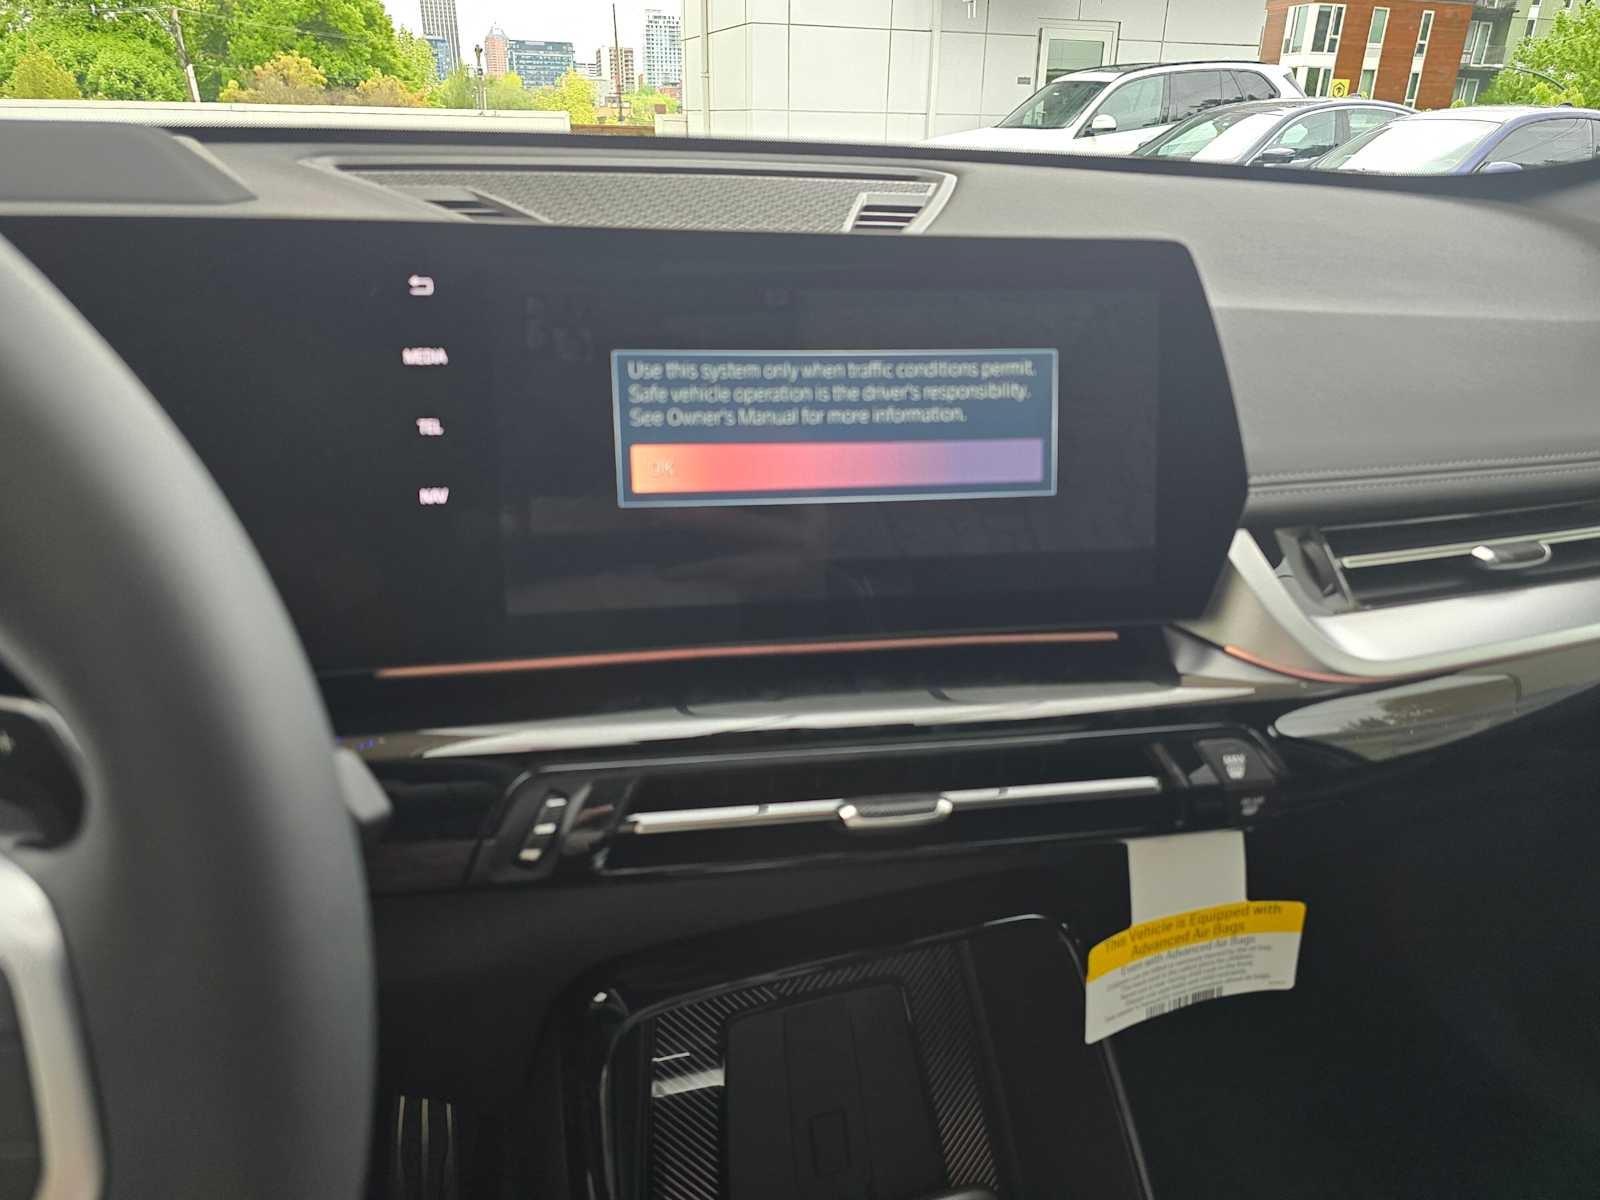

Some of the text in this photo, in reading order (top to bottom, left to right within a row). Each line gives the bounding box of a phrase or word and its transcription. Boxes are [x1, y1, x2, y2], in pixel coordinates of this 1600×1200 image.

[627, 360, 1036, 383] Use this system only when traffic conditions permit.
[628, 382, 1031, 405] Safe vehicle operation is the driver's responsibility.
[629, 406, 967, 427] See Owner's Manual for more information.
[1129, 921, 1173, 942] Vehicle
[1189, 906, 1249, 928] Equipped
[1252, 903, 1282, 915] with
[1131, 921, 1246, 958] Advanced Air Bags
